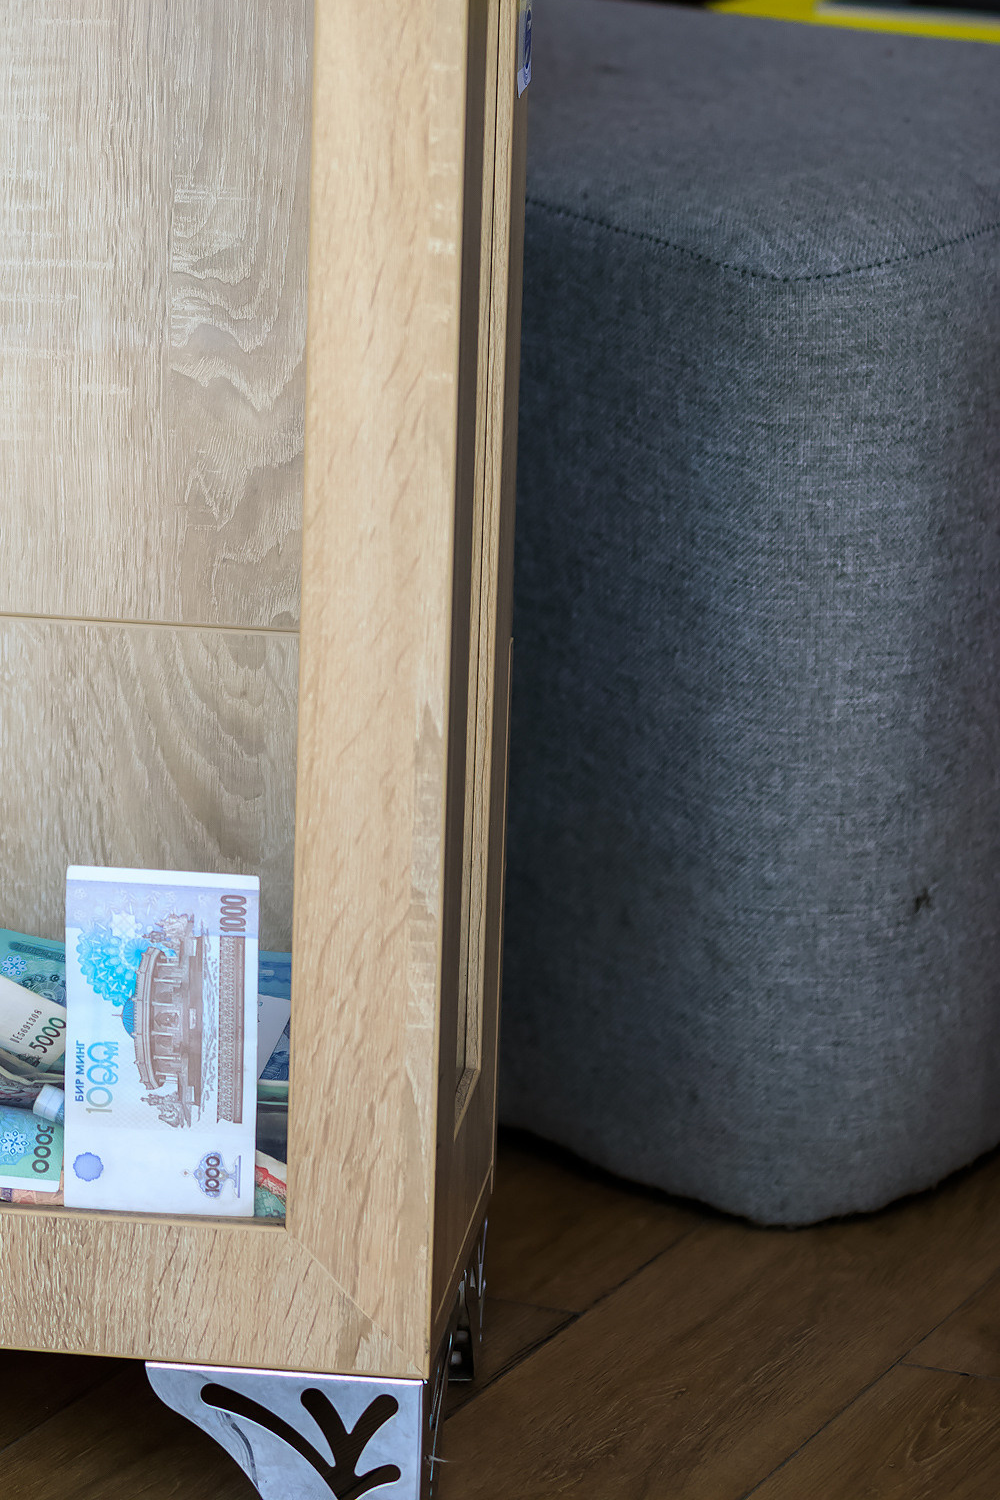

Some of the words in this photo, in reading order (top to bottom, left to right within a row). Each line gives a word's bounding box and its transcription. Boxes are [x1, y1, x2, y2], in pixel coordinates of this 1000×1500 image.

[219, 894, 248, 932] 1000
[29, 1017, 67, 1054] 5000
[74, 1039, 86, 1074] МИНГ
[74, 1075, 85, 1103] БИР
[85, 1041, 114, 1114] 1000
[31, 1123, 55, 1174] 5000
[204, 1155, 221, 1194] 1000
